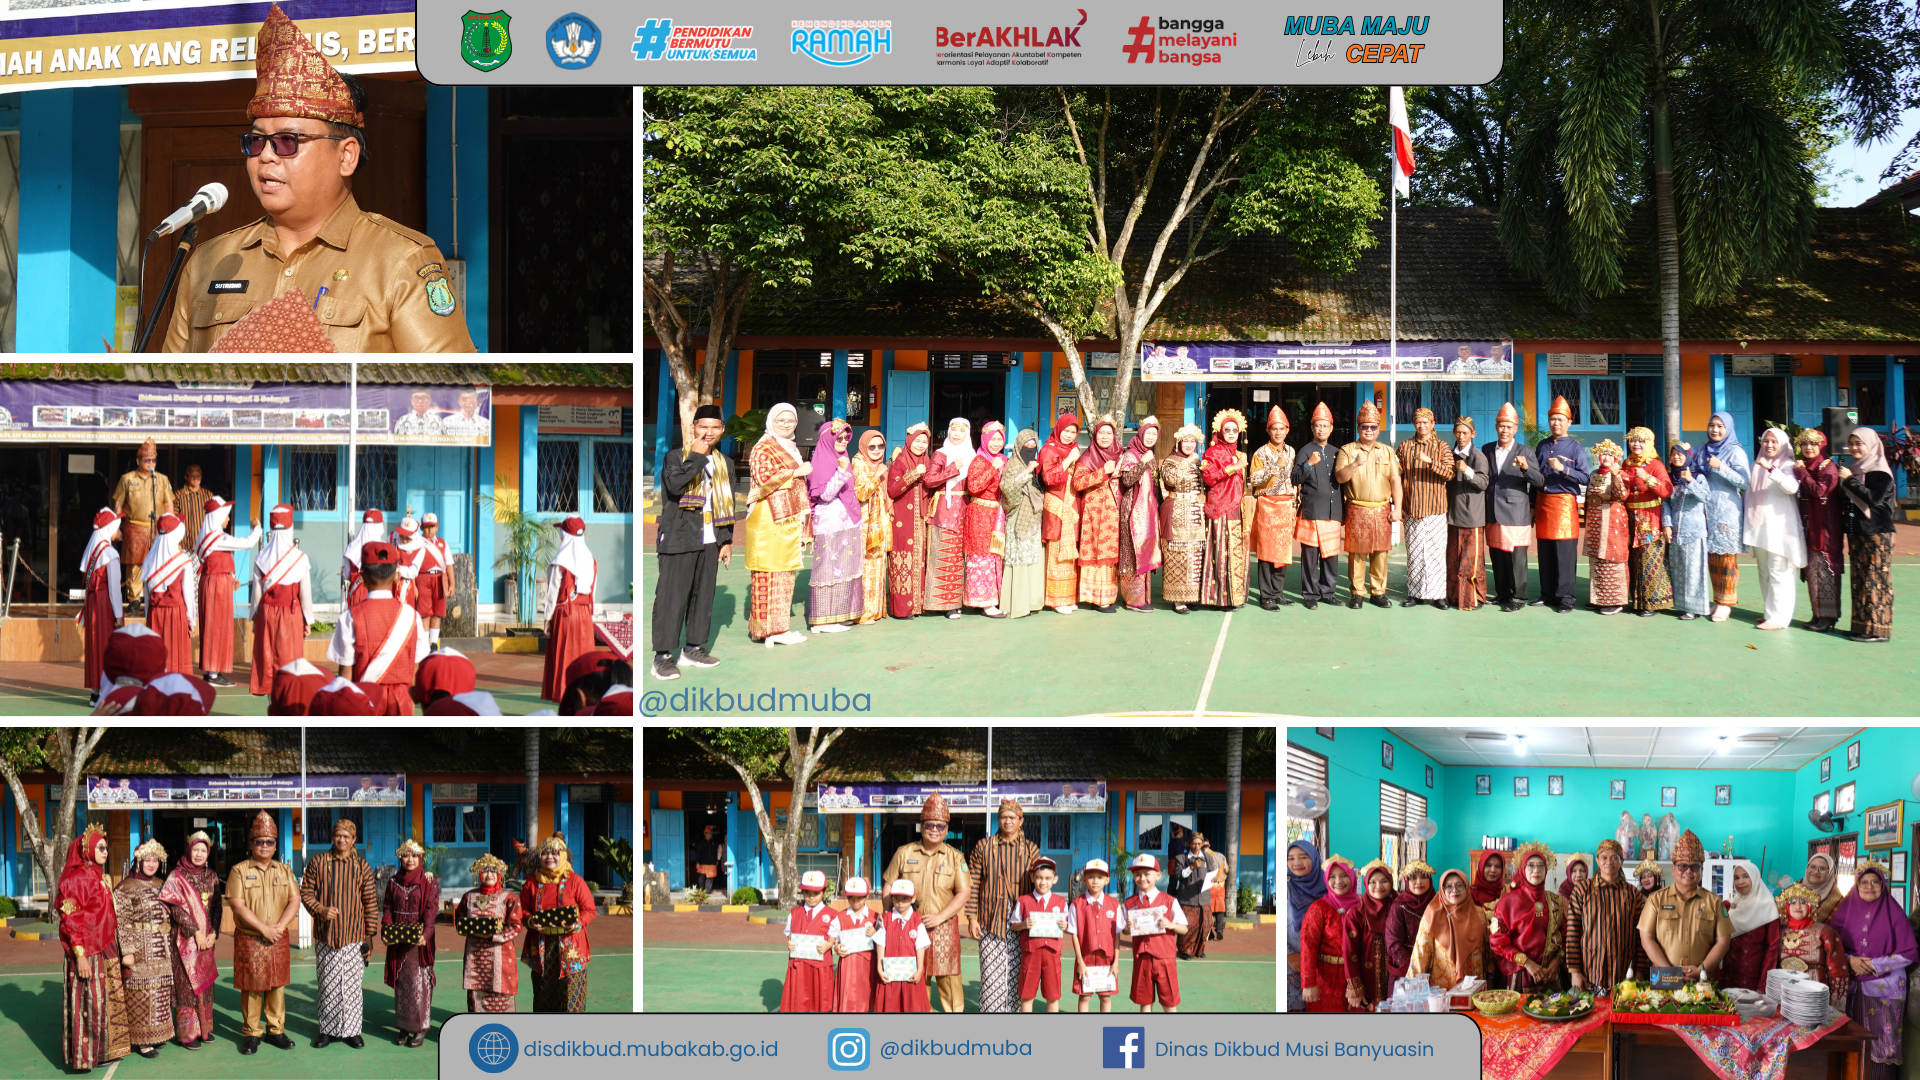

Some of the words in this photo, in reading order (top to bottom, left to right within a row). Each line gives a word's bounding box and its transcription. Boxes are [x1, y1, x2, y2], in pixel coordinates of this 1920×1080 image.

[50, 45, 122, 73] ANAK
[129, 40, 202, 68] YANG
[174, 394, 203, 403] Datang
[226, 395, 253, 403] Negeri
